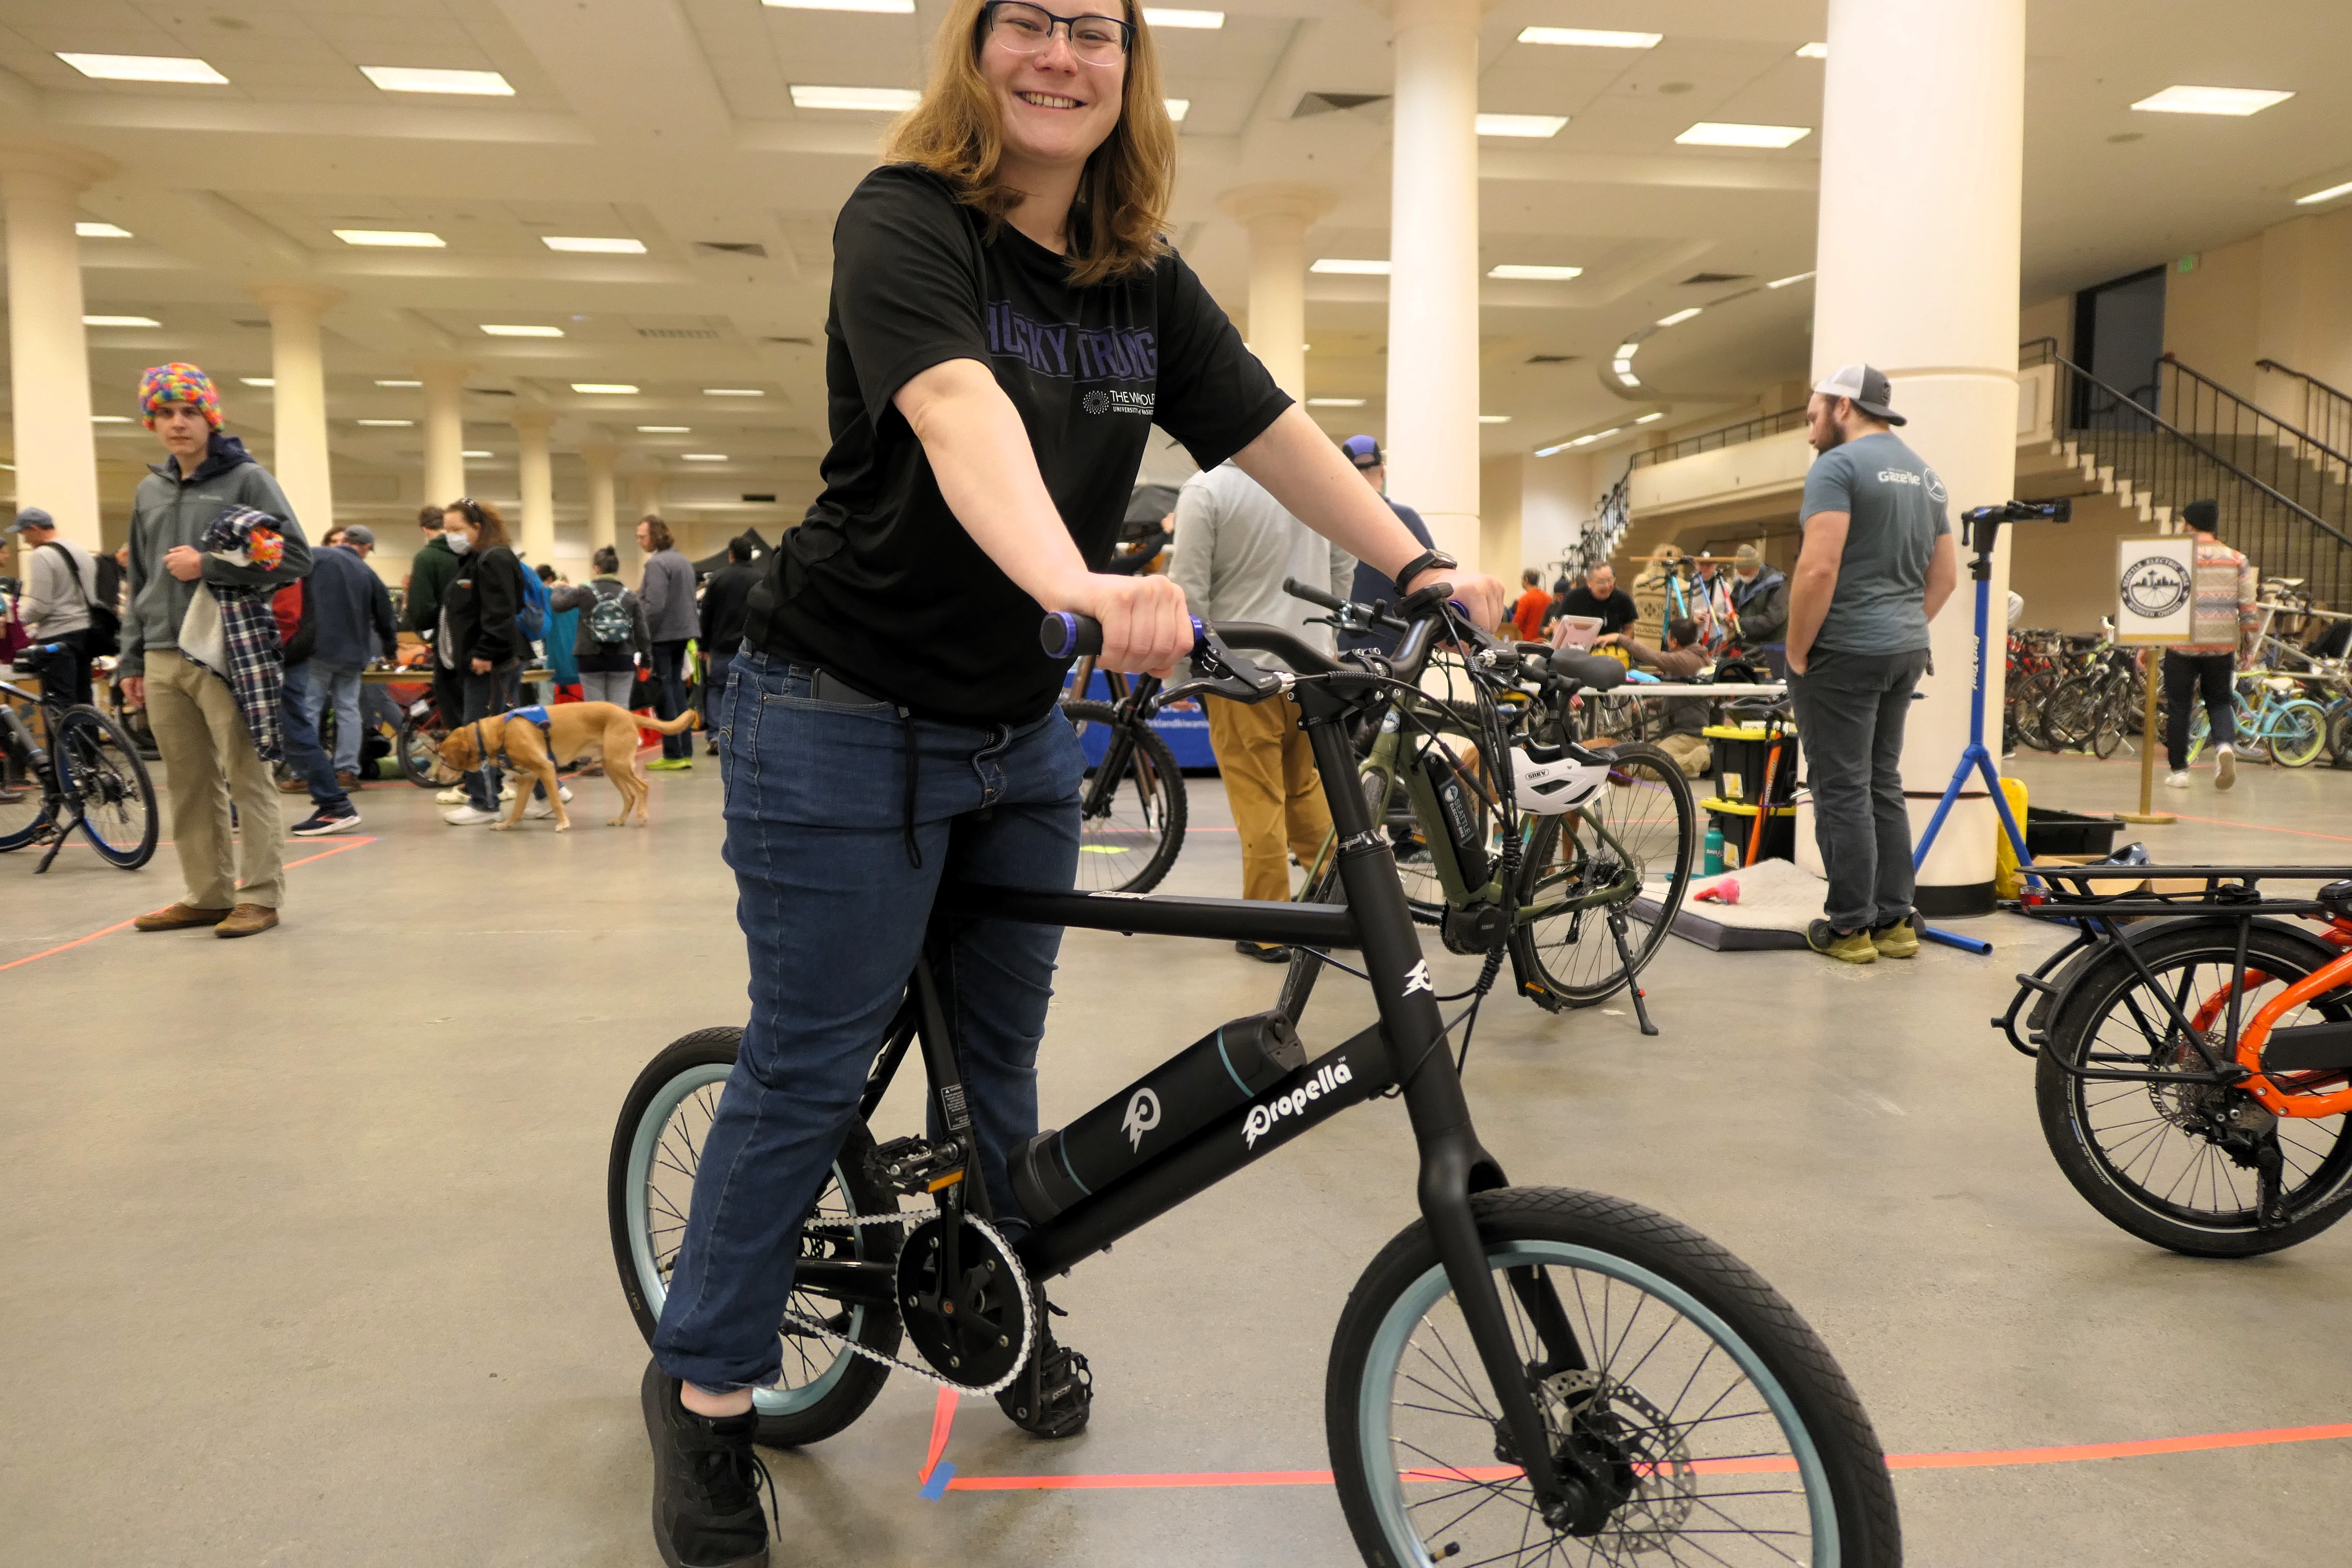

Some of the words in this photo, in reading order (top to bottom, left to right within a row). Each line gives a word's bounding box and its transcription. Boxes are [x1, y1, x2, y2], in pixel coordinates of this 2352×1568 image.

[1110, 390, 1129, 402] THE
[1878, 470, 1920, 486] Gazelle
[2146, 558, 2180, 570] ELECTRIC
[2128, 603, 2155, 617] WORKER
[2158, 601, 2182, 617] OWNED
[1528, 770, 1546, 779] ABUS
[1450, 803, 1461, 828] ELECTRIC
[1454, 799, 1471, 836] SEATTLE
[1241, 1063, 1353, 1151] Propella
